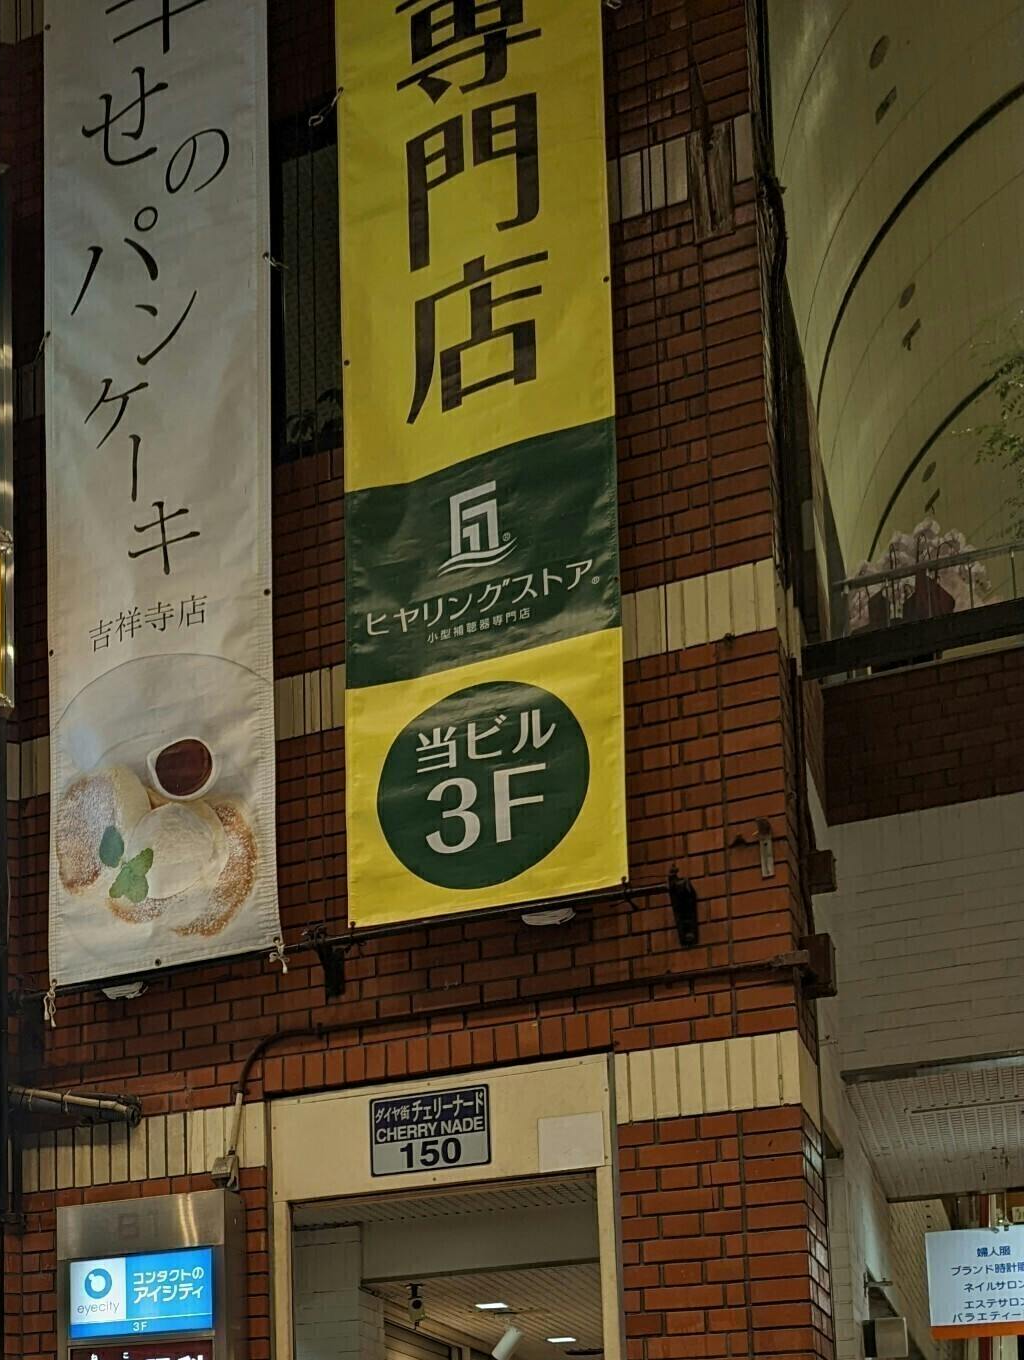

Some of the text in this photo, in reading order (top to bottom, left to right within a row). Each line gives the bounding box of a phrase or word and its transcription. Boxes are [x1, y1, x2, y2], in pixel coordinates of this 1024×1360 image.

[366, 558, 593, 636] ヒヤリングストア
[88, 594, 208, 652] 吉祥寺店
[427, 607, 531, 644] 小型補聴器専門店
[413, 707, 557, 775] 当ビル
[425, 762, 548, 855] 3F
[376, 1116, 484, 1143] CHERRY NADE
[399, 1137, 462, 1168] 150
[976, 1245, 1011, 1258] 婦人服
[133, 1266, 205, 1285] コンタクトの
[77, 1301, 120, 1315] eyecity
[133, 1284, 205, 1305] アイシティ
[133, 1321, 148, 1332] 3F
